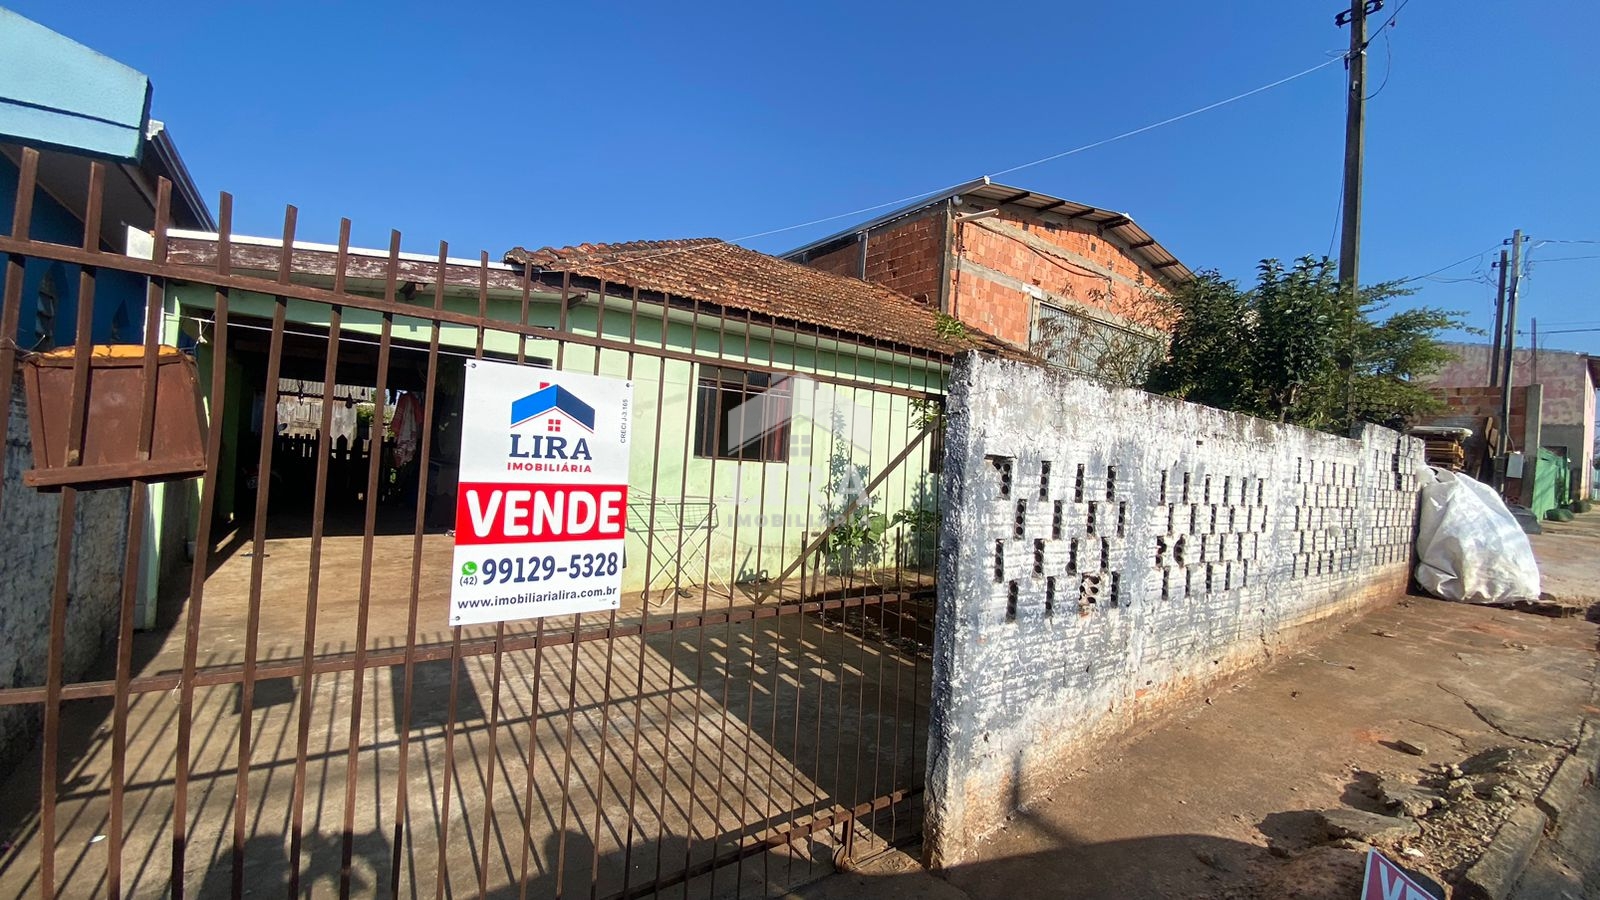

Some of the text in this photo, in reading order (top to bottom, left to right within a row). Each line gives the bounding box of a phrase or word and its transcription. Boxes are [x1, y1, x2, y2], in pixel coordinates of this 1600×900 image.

[509, 433, 593, 461] LIRA
[507, 461, 592, 473] IMOBILIÁRIA
[465, 489, 622, 538] VENDE
[459, 552, 619, 587] (42) 99129-5328
[457, 586, 617, 609] www.imobiliarialira.com.br
